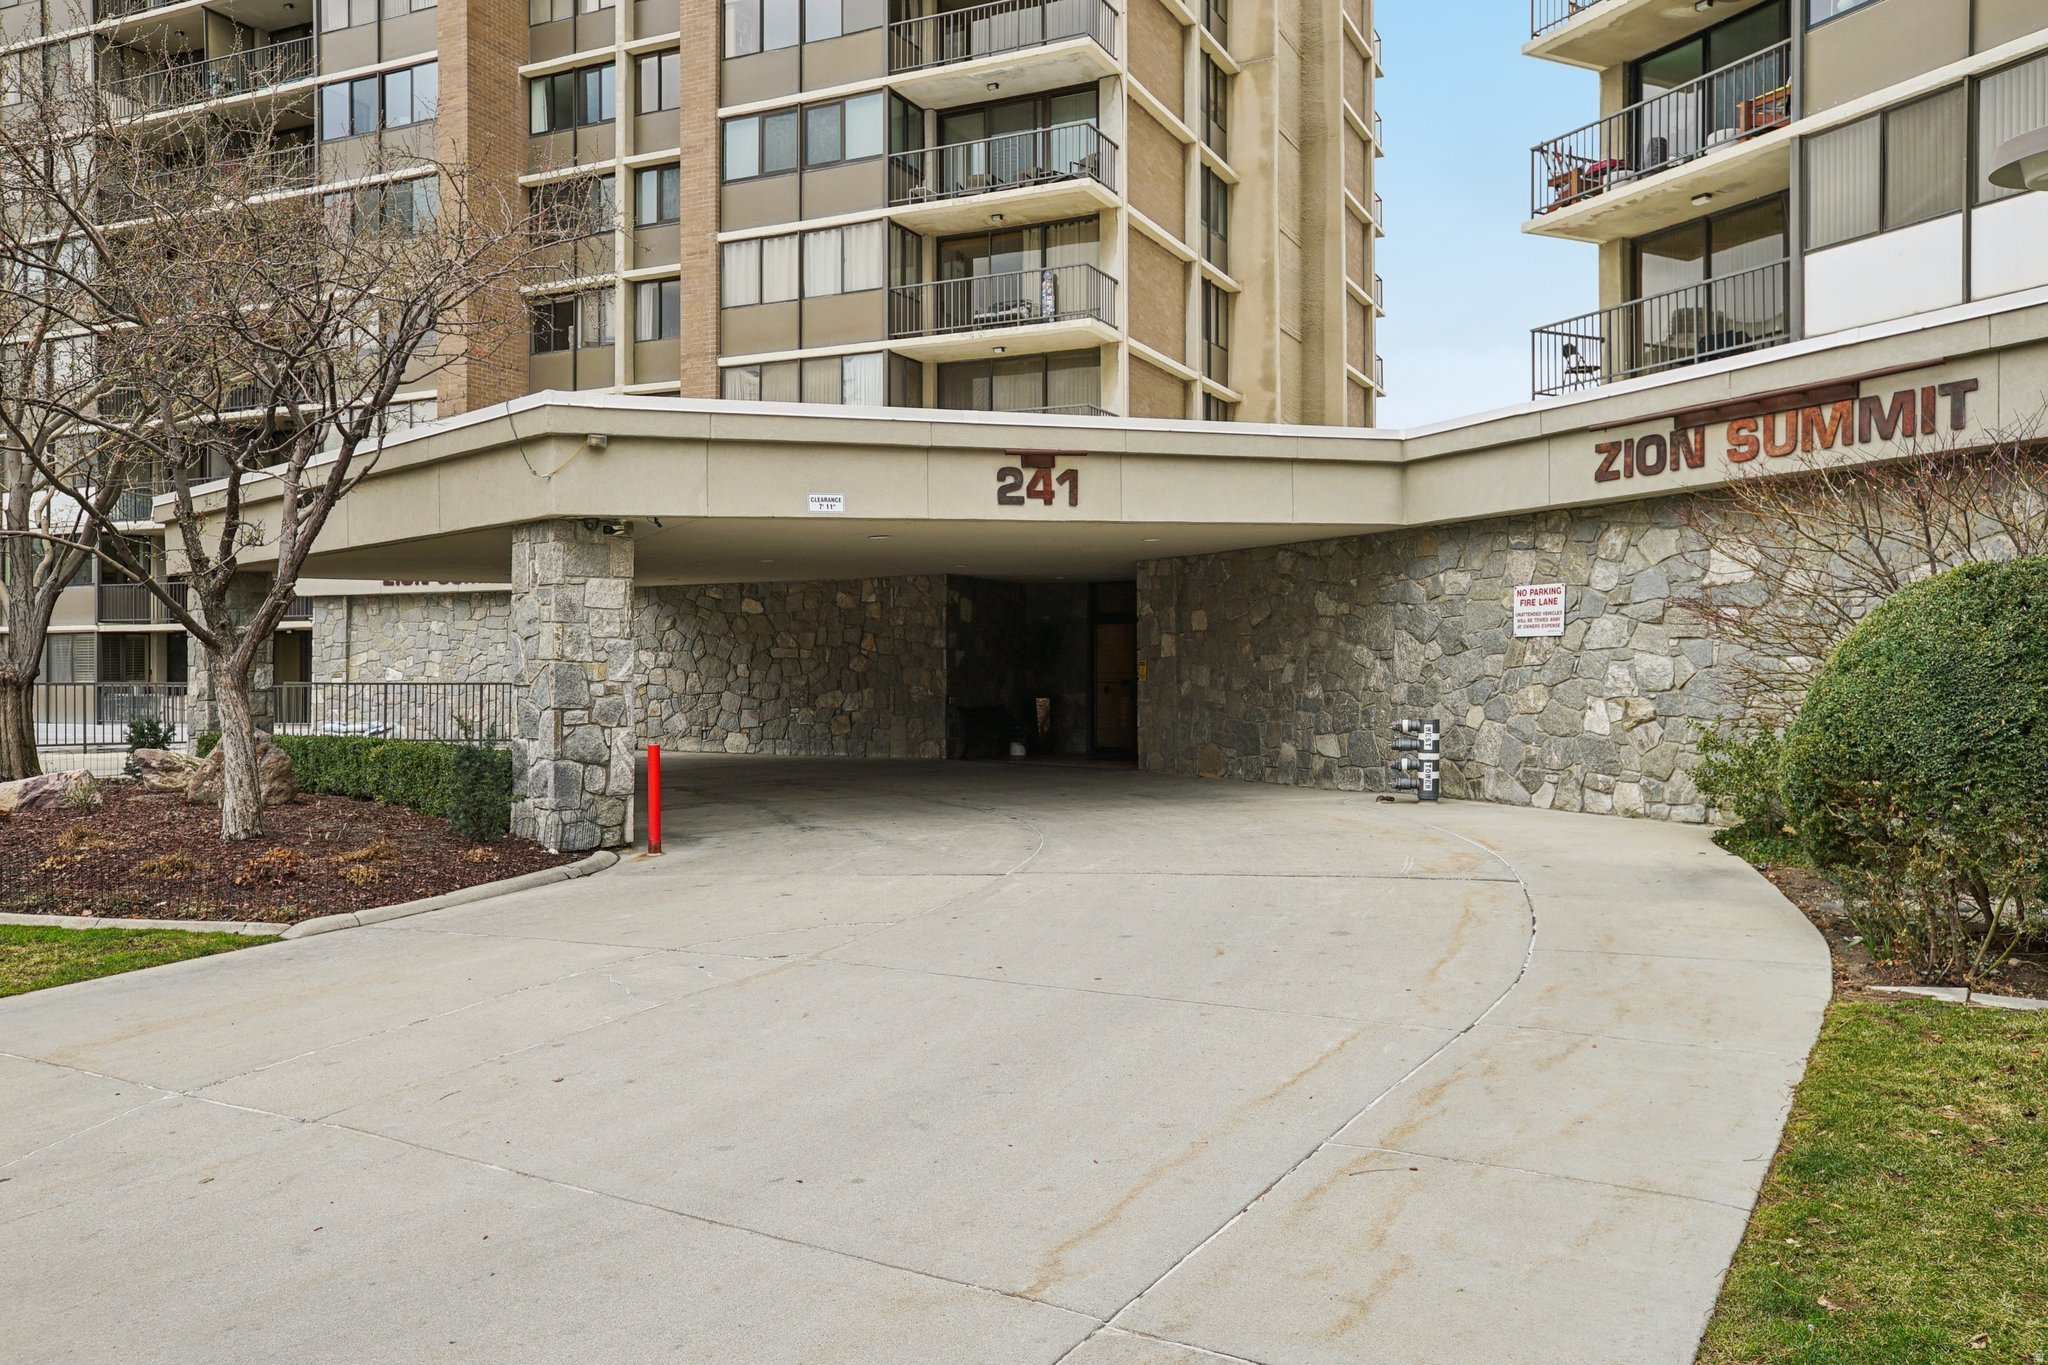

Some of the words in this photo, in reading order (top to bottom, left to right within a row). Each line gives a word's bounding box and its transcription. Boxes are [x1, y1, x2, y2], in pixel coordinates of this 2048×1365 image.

[1594, 425, 1706, 483] ZION
[1725, 377, 1980, 464] SUMMIT
[996, 466, 1078, 507] 241
[1517, 589, 1527, 597] NO
[1530, 587, 1561, 596] PARKING
[1539, 597, 1558, 605] LANE
[1424, 726, 1432, 748] WEST
[1424, 763, 1432, 790] TOWER
